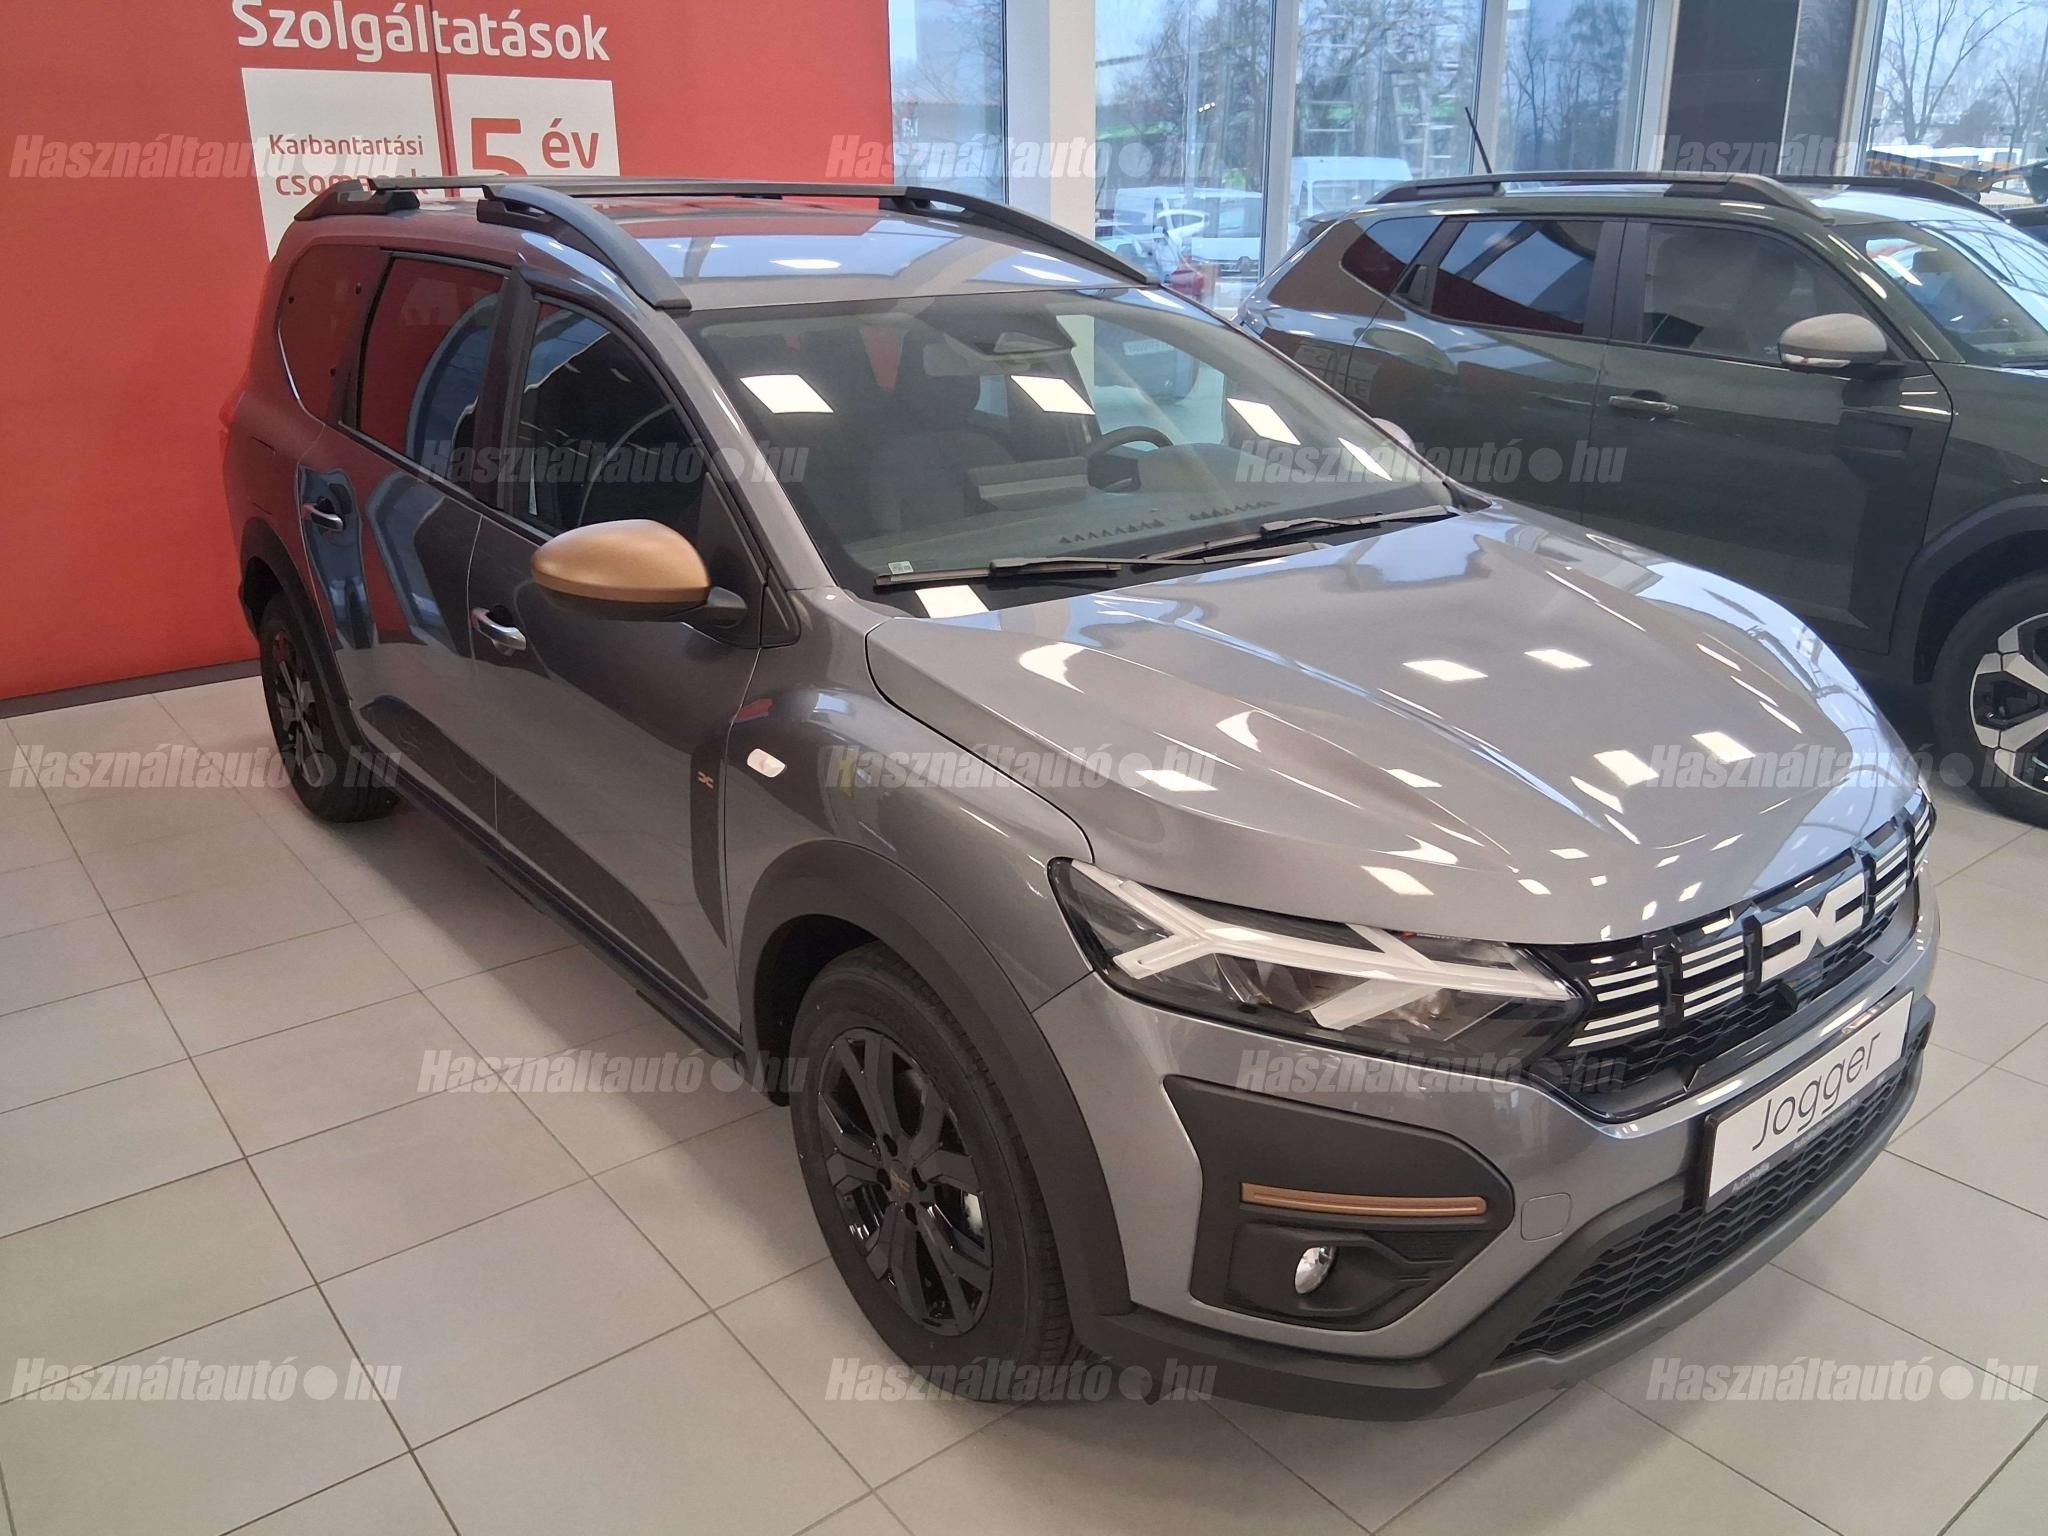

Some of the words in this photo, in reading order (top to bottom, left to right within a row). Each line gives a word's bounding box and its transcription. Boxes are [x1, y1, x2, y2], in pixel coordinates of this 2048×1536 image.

[232, 0, 610, 62] Szolgáltatások
[268, 134, 424, 155] Karbantartási
[471, 118, 528, 175] 5
[542, 118, 599, 168] év
[1752, 1032, 1880, 1151] Jogger
